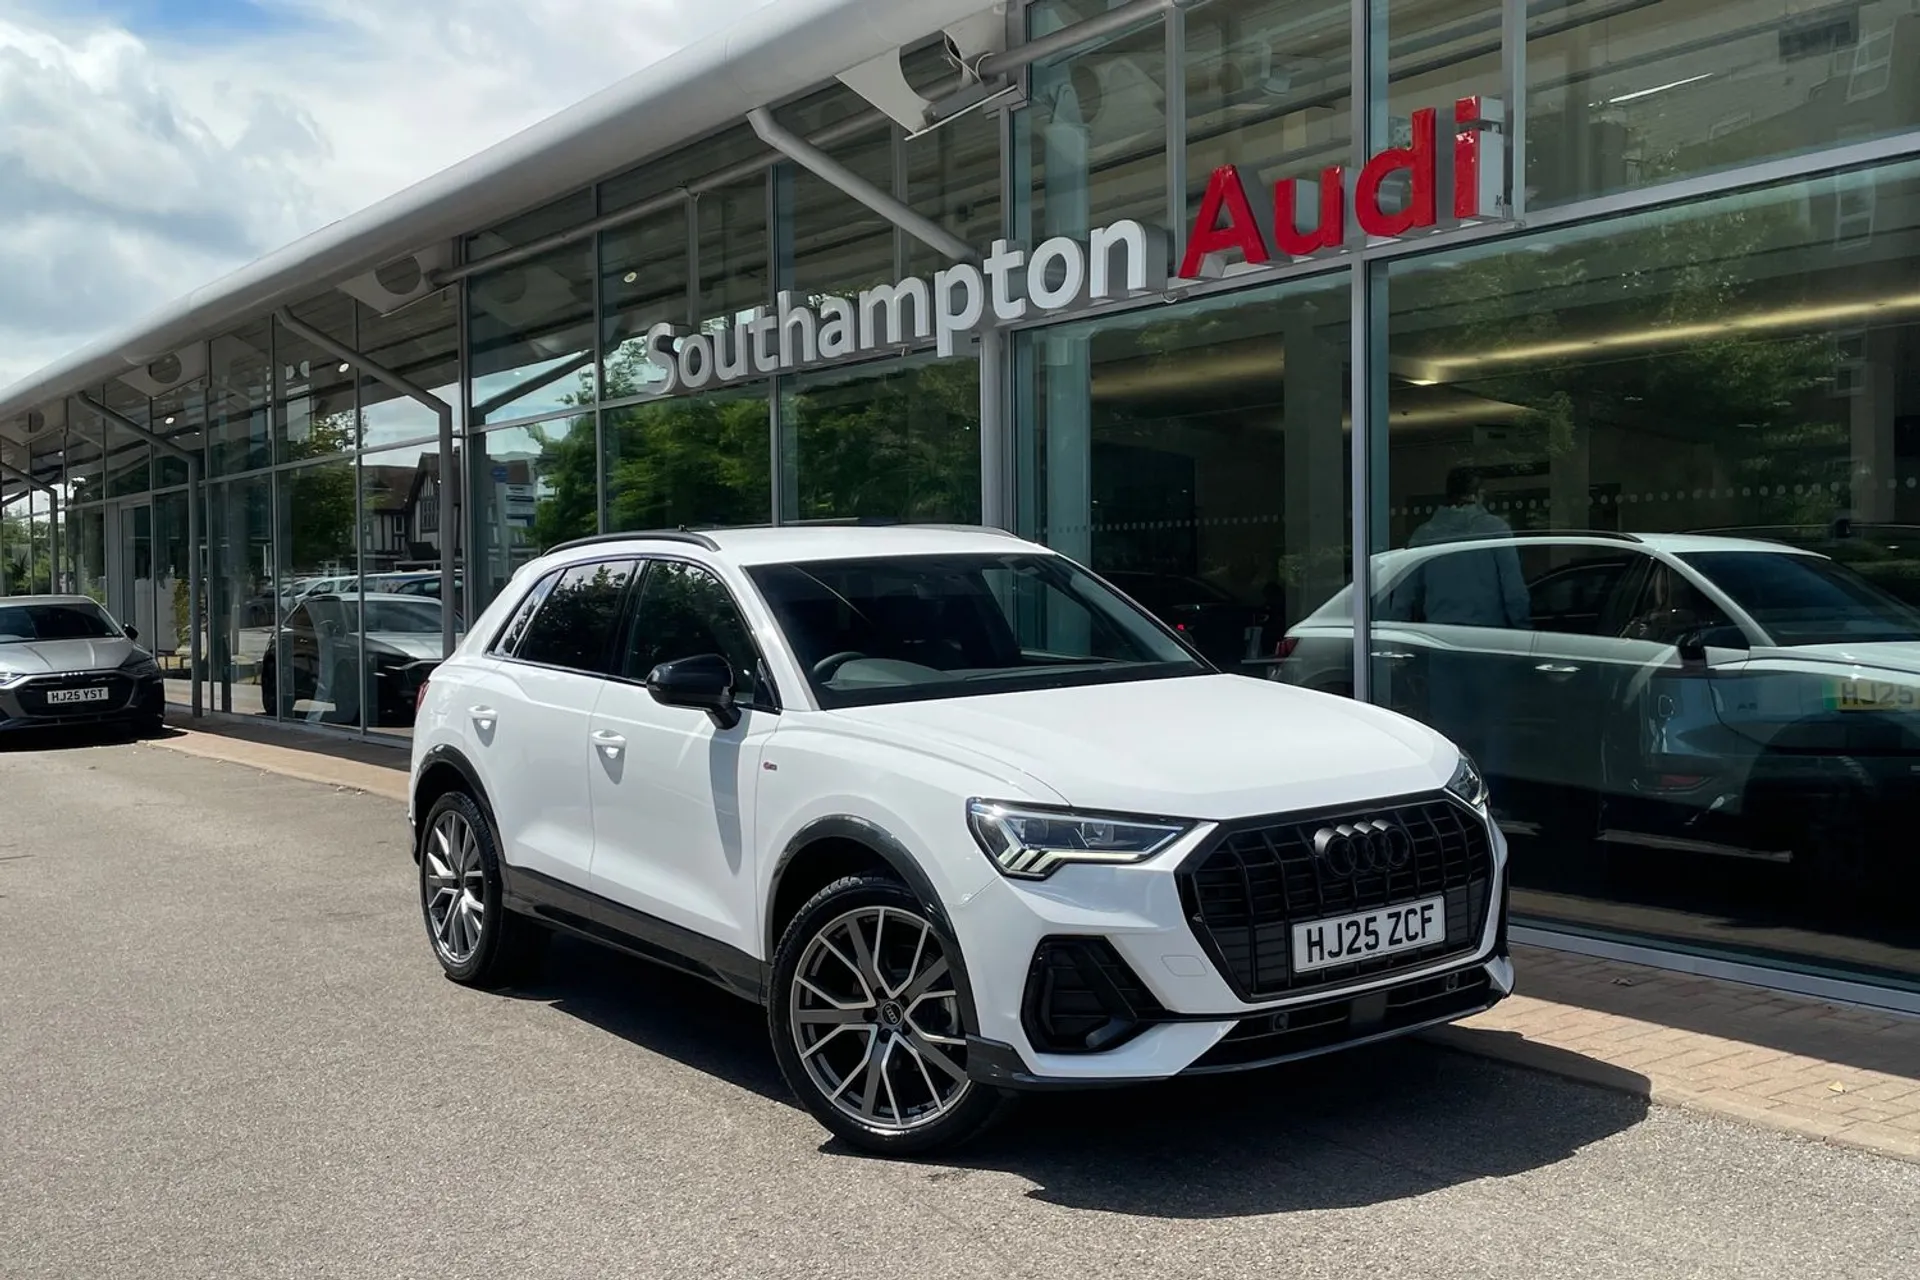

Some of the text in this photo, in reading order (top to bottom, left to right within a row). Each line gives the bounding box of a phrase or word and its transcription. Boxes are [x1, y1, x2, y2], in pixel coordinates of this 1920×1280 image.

[645, 95, 1480, 395] Southampton Audi
[51, 688, 104, 702] HJ25 YST
[1842, 682, 1914, 705] HJ25
[1306, 904, 1434, 963] HJ25 ZCF
